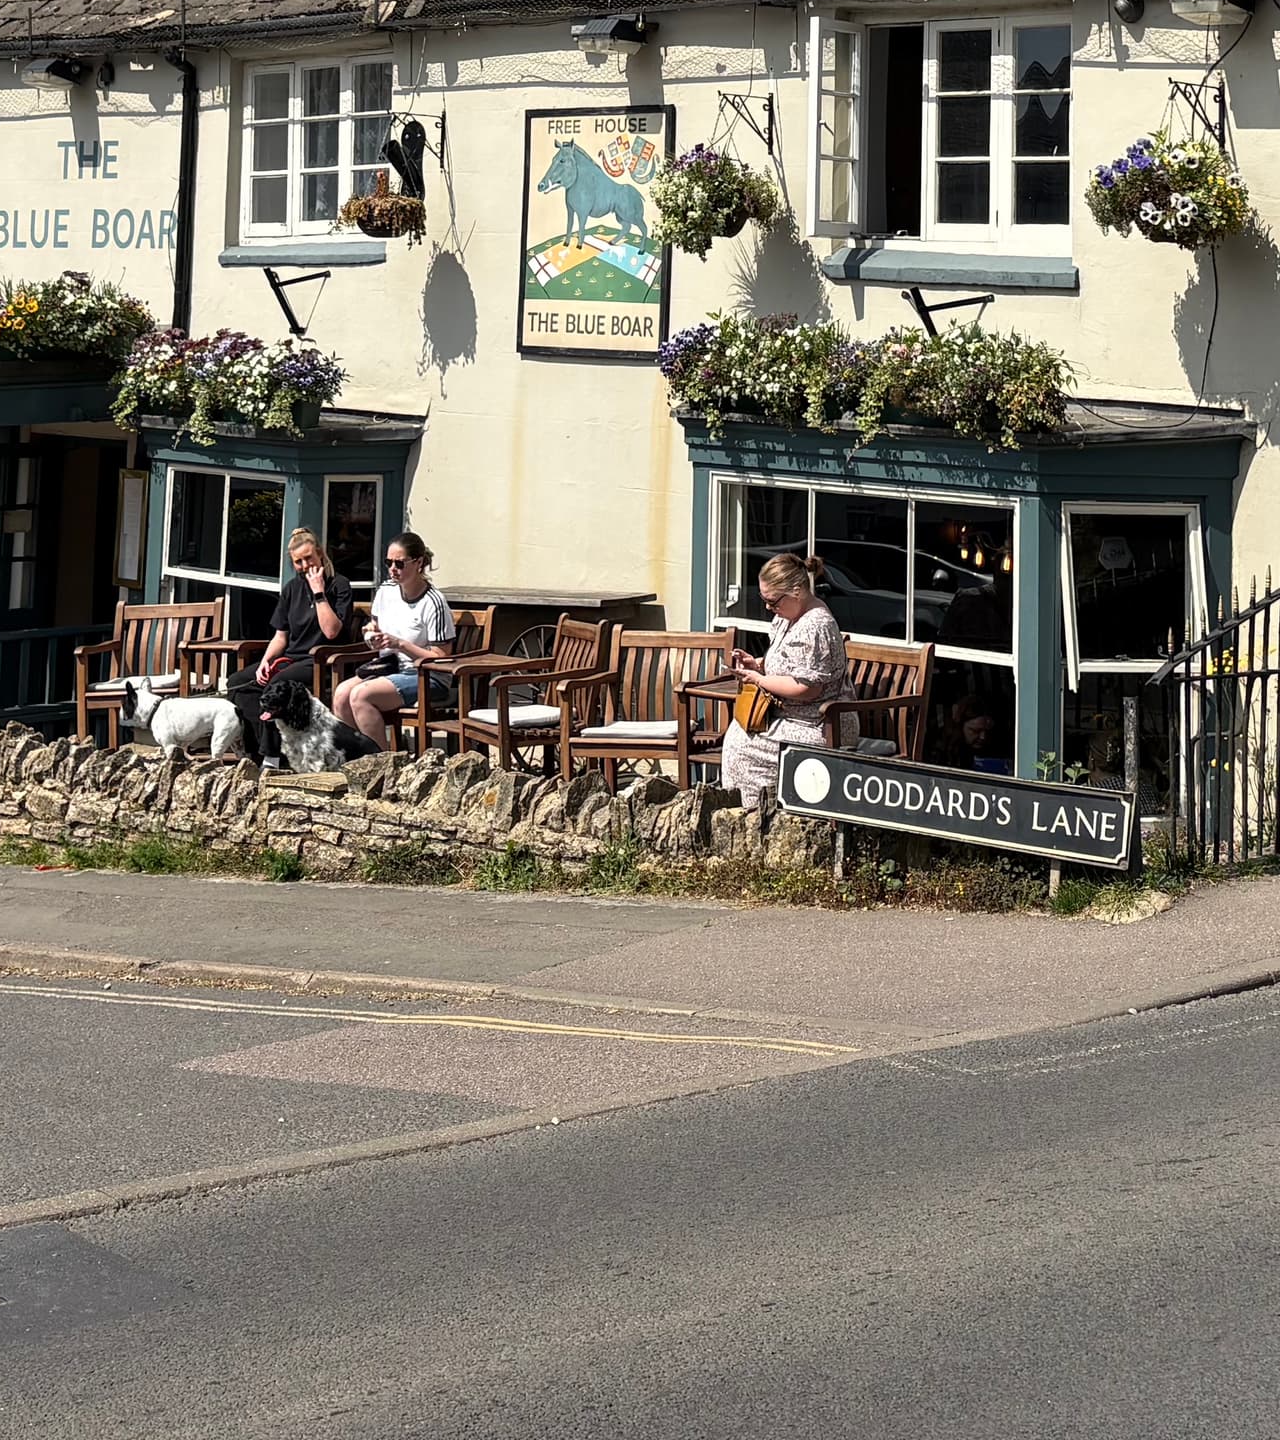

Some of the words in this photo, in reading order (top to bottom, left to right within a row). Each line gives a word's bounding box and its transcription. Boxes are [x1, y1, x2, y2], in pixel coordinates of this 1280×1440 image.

[547, 119, 581, 134] FREE
[594, 117, 647, 134] HOUSE
[57, 140, 119, 180] THE
[91, 209, 178, 249] BOAR
[528, 312, 559, 333] THE
[565, 313, 606, 335] BLUE
[611, 315, 654, 338] BOAR
[843, 773, 1012, 826] GODDARD'S
[1032, 802, 1117, 842] LANE
